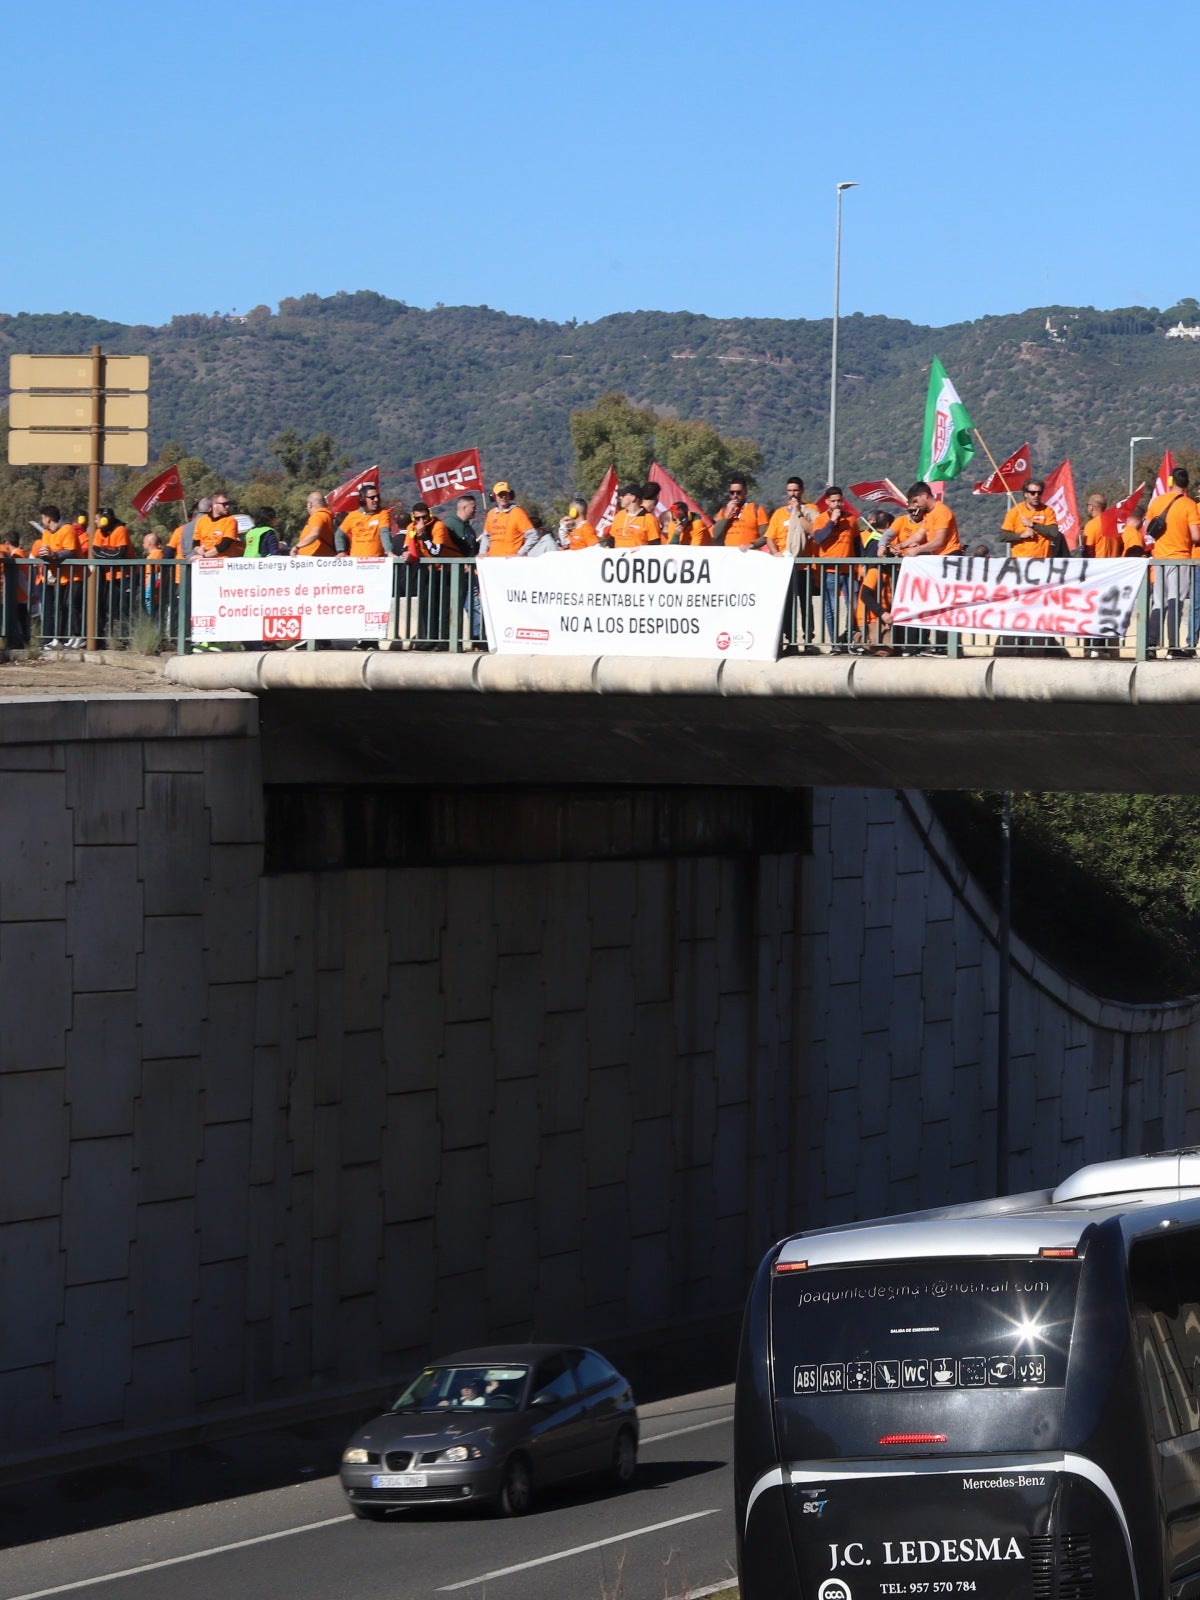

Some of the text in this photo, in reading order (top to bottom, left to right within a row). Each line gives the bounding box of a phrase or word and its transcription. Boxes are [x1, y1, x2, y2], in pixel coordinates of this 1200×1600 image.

[227, 562, 256, 571] Hitachi
[258, 561, 287, 572] Energy
[290, 560, 314, 570] Spain
[600, 552, 711, 584] CÓRDOBA
[942, 557, 1089, 585] HITACHI
[219, 584, 365, 598] Inversiones de primera
[507, 589, 756, 607] UNA EMPRESA RENTABLE Y CON BENEFICIOS
[900, 572, 1099, 613] INVERSIONES
[218, 604, 365, 617] Condiciones de tercera
[366, 613, 383, 624] UGT
[264, 618, 300, 638] USO
[560, 616, 700, 634] NO A LOS DESPIDOS
[797, 1370, 815, 1388] ABS
[822, 1371, 842, 1387] ASR
[904, 1366, 926, 1382] WC
[963, 1476, 1046, 1489] Mercedes-Benz
[803, 1501, 828, 1513] SC7
[829, 1537, 1025, 1571] J.C. LEDESMA
[880, 1581, 976, 1594] TEL: 957 570 784
